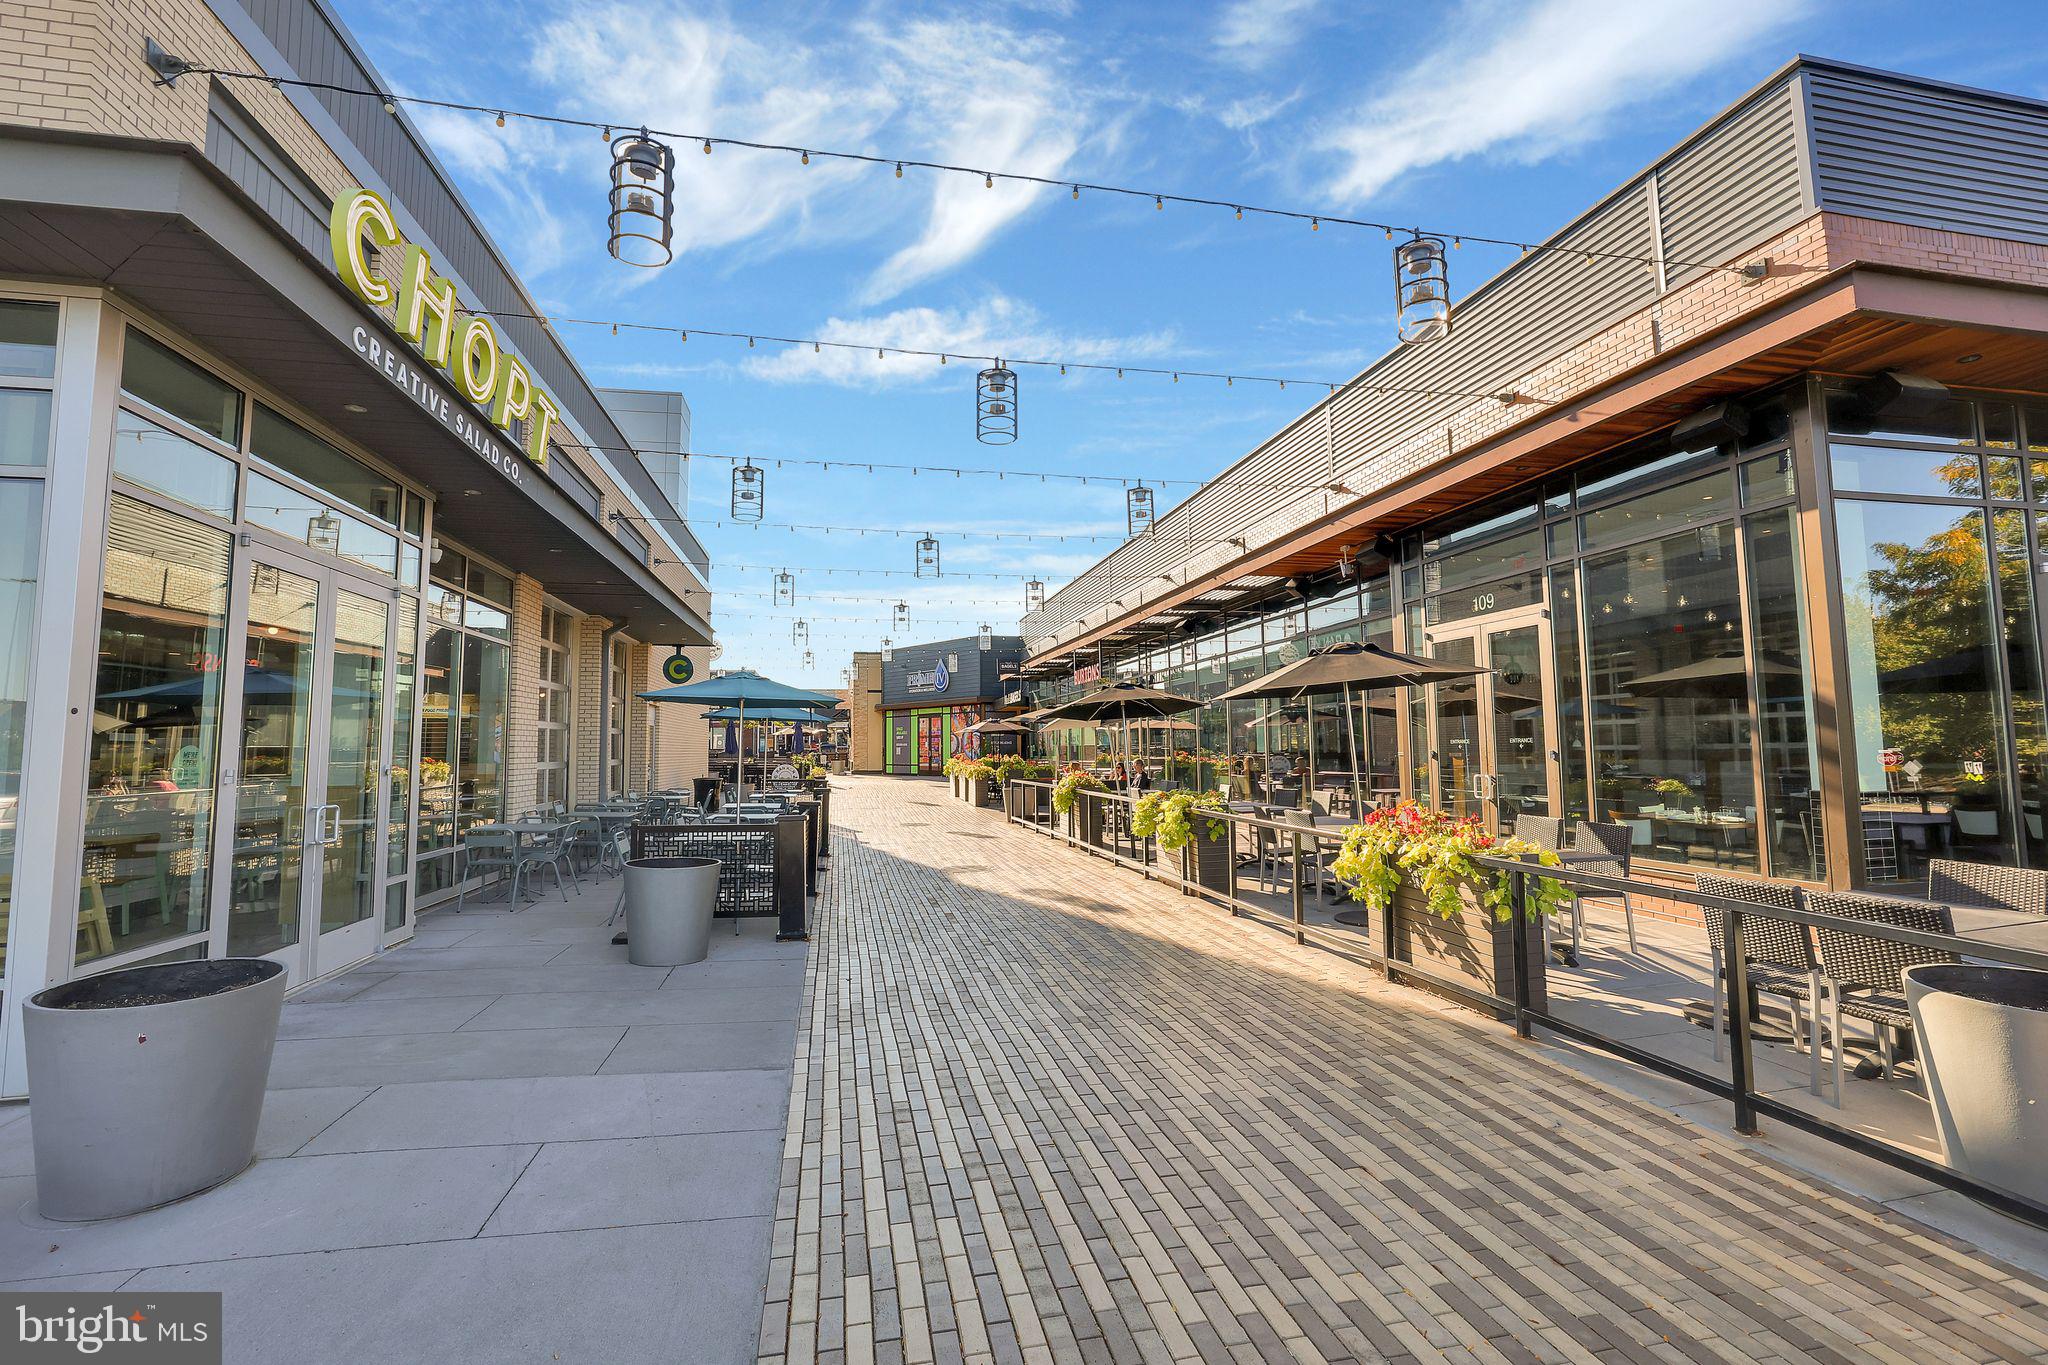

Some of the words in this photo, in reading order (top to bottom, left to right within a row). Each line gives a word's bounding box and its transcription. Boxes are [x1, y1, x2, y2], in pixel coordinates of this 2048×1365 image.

[330, 187, 559, 465] CHOPT
[352, 326, 449, 423] CREATIVE
[455, 413, 500, 465] SALAD
[503, 455, 523, 485] CO.
[1472, 593, 1494, 611] 109
[669, 660, 687, 679] C
[936, 672, 946, 683] IV
[1074, 662, 1100, 685] BURTONS
